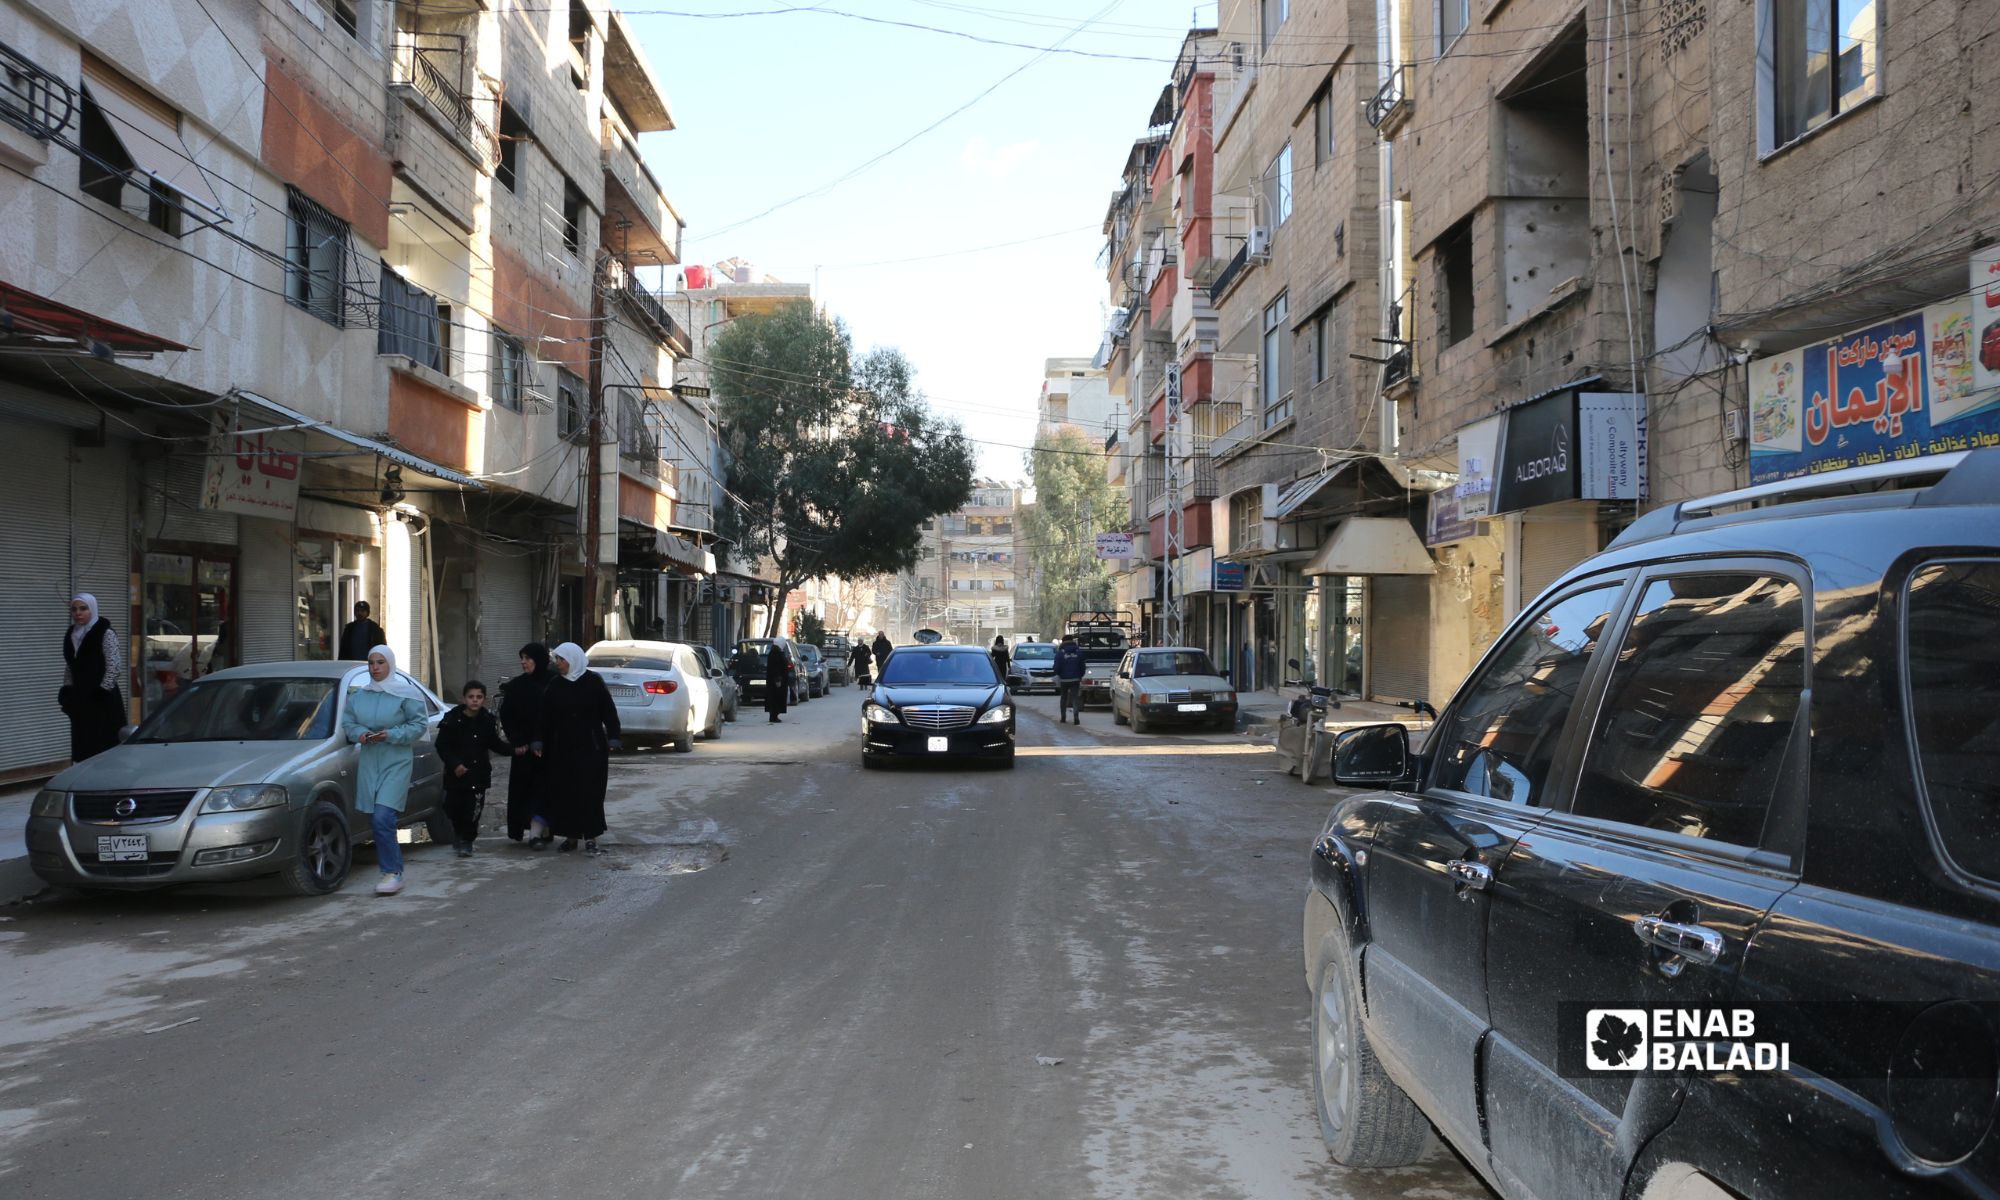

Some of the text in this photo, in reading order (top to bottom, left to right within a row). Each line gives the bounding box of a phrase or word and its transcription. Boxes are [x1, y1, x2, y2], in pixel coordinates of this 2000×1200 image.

[1838, 335, 1878, 368] ماركت
[1608, 426, 1617, 475] Composite
[1929, 435, 1967, 455] غذائية
[1971, 431, 2000, 448] مواد
[1515, 452, 1567, 484] ALBORAQ
